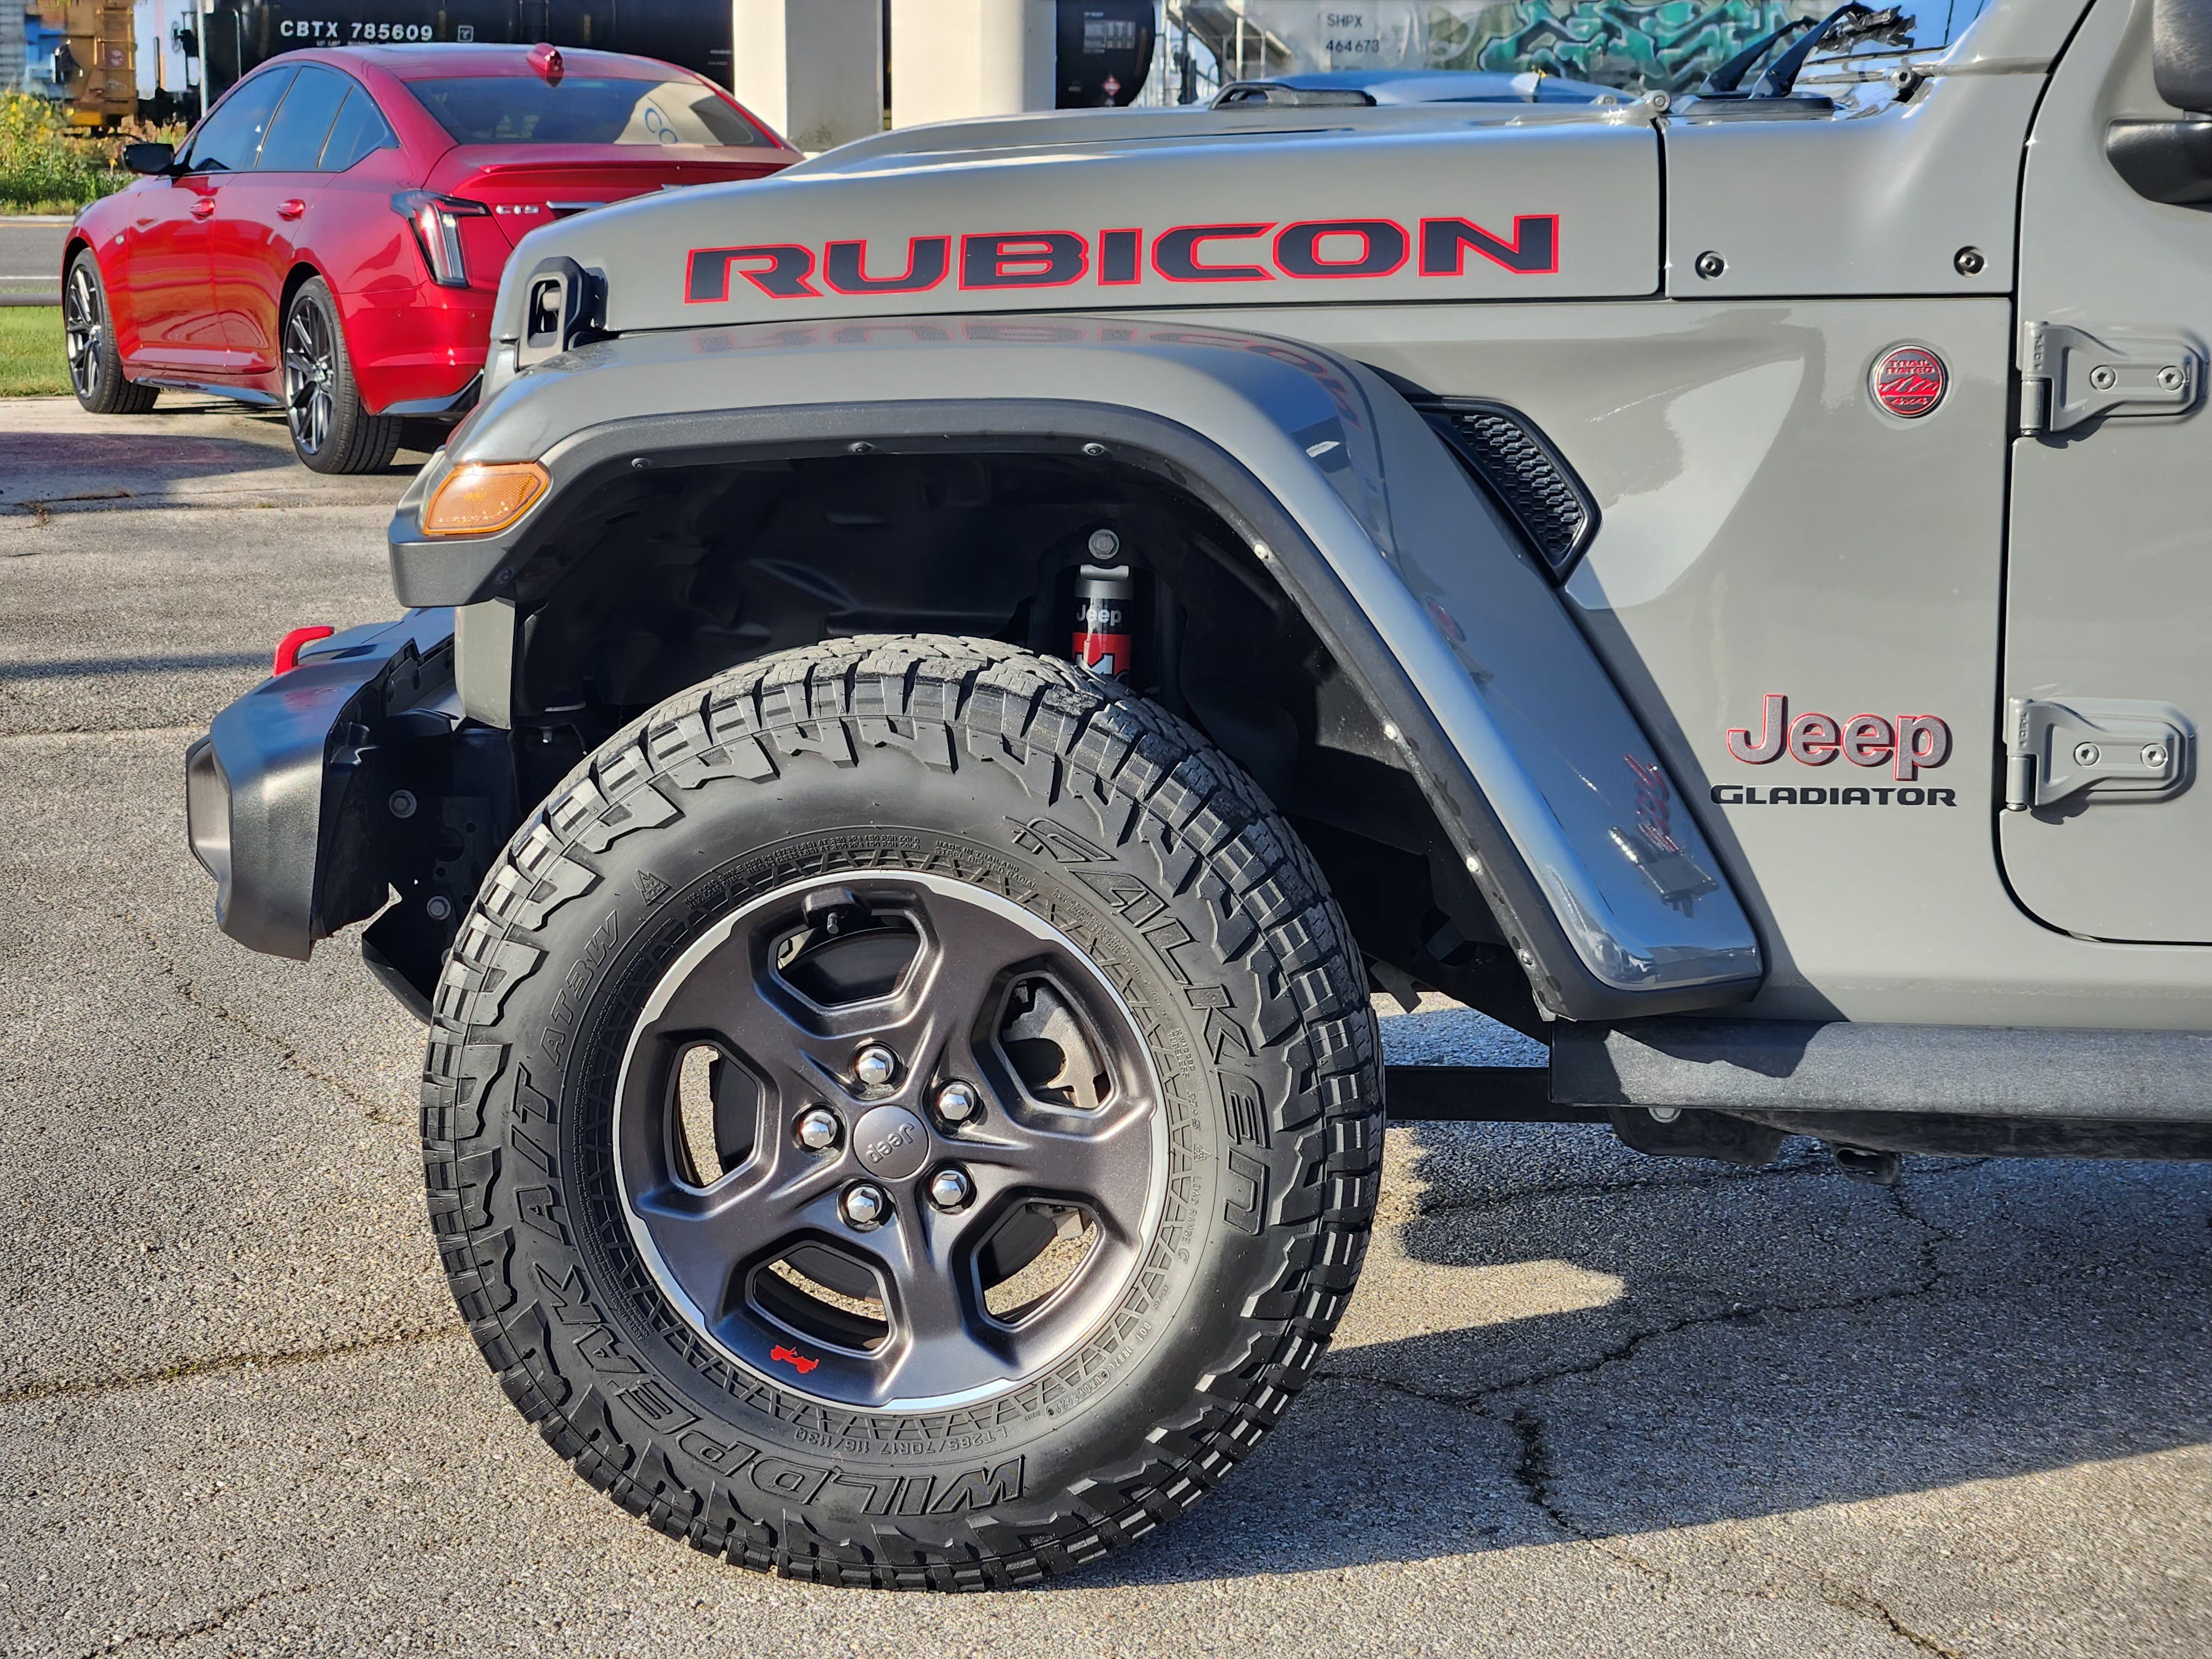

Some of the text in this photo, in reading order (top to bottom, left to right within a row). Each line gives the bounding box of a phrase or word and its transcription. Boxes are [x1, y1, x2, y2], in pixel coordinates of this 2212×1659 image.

[280, 19, 433, 41] CBTX 785609
[1327, 13, 1363, 28] SHPX
[1326, 39, 1380, 53] 464673
[684, 214, 1559, 304] RUBICON
[1890, 397, 1928, 405] 4x4
[1076, 604, 1122, 627] Jeep
[1726, 694, 1953, 781] Jeep
[1710, 784, 1958, 807] GLADIATOR
[975, 850, 1020, 873] THAILAND
[1004, 816, 1270, 1235] FALKEN
[1167, 1031, 1189, 1077] TUBELESS
[867, 1123, 915, 1164] Jeep
[1191, 1176, 1201, 1204] LOAD
[1182, 1208, 1197, 1243] RANGE
[1135, 1321, 1152, 1342] DOT
[534, 1262, 1025, 1516] WILDPEAK
[880, 1425, 1008, 1454] LT285/70R17
